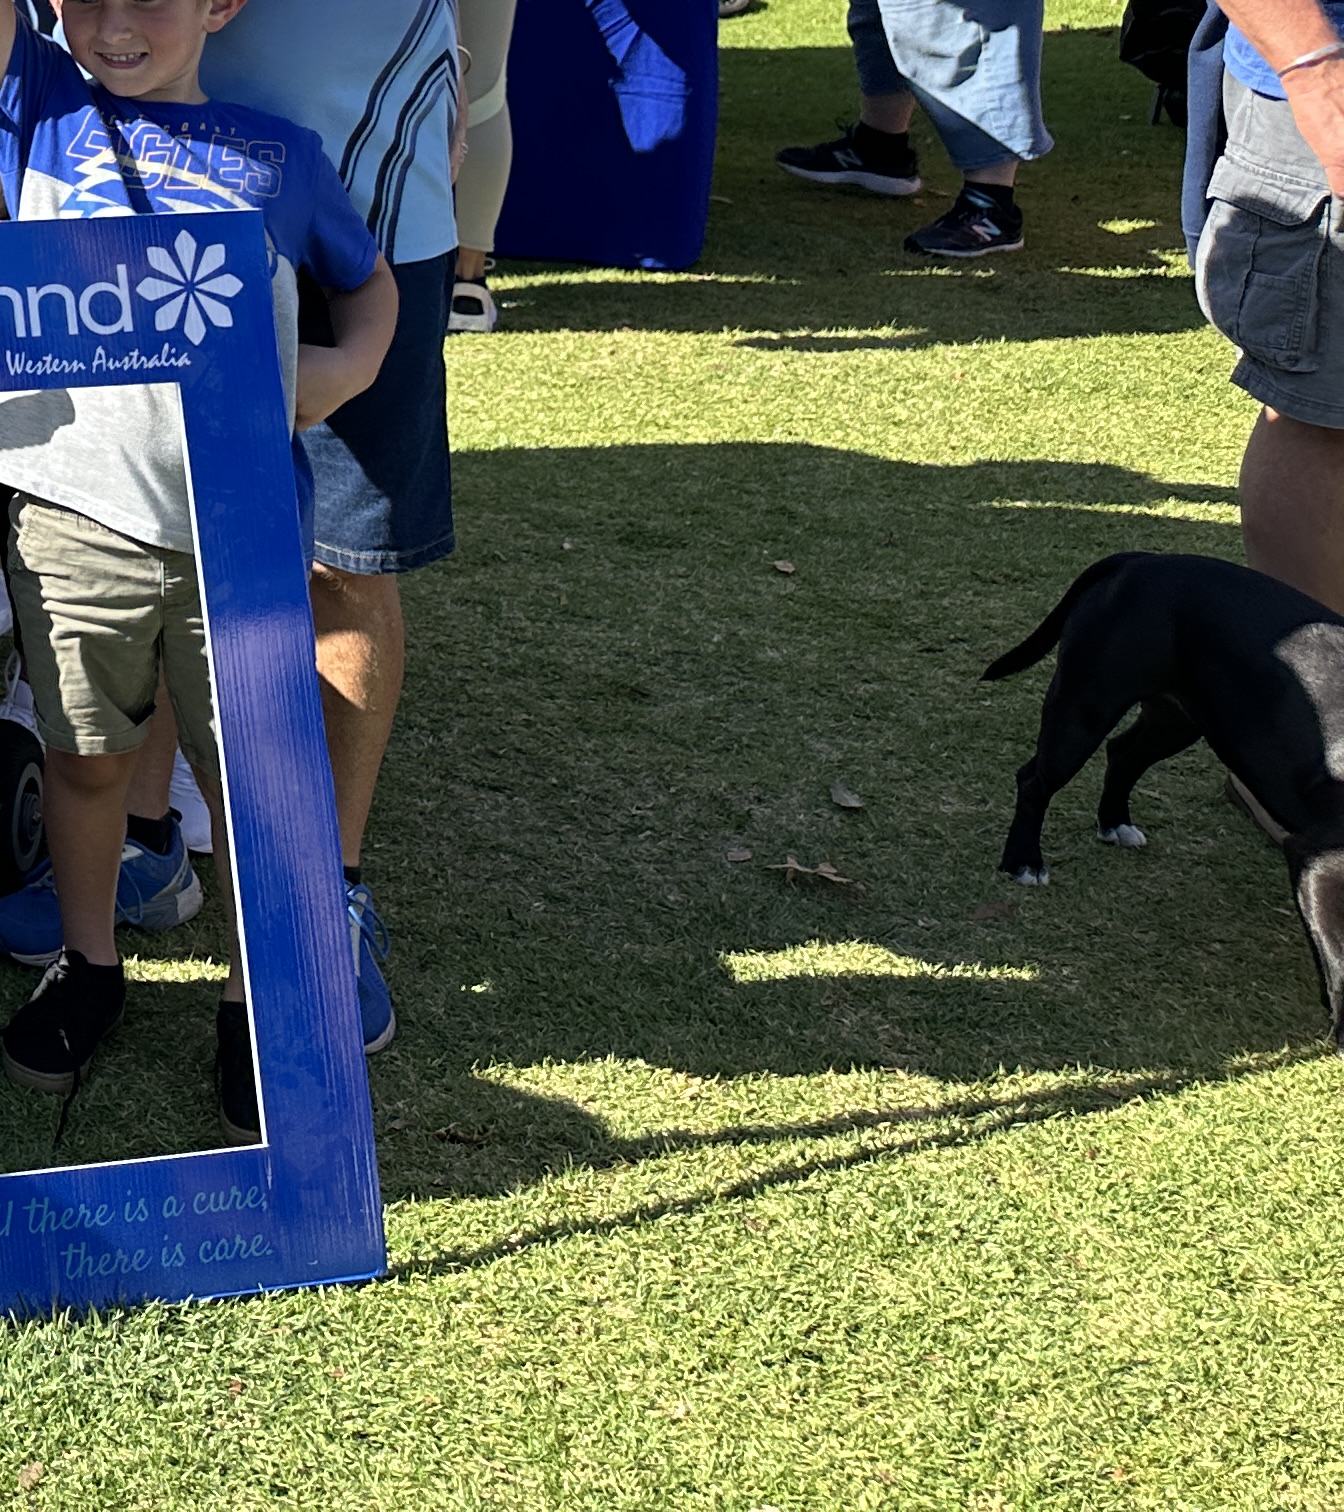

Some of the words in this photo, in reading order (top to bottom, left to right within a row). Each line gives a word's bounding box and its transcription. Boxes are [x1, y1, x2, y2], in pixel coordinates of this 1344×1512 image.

[5, 347, 86, 377] Western
[92, 342, 192, 374] Australia
[23, 1196, 114, 1235] there
[122, 1189, 150, 1224] is
[161, 1197, 186, 1219] a
[193, 1184, 269, 1216] cure,
[61, 1242, 153, 1281] there
[161, 1234, 187, 1269] is
[198, 1231, 275, 1265] care.
